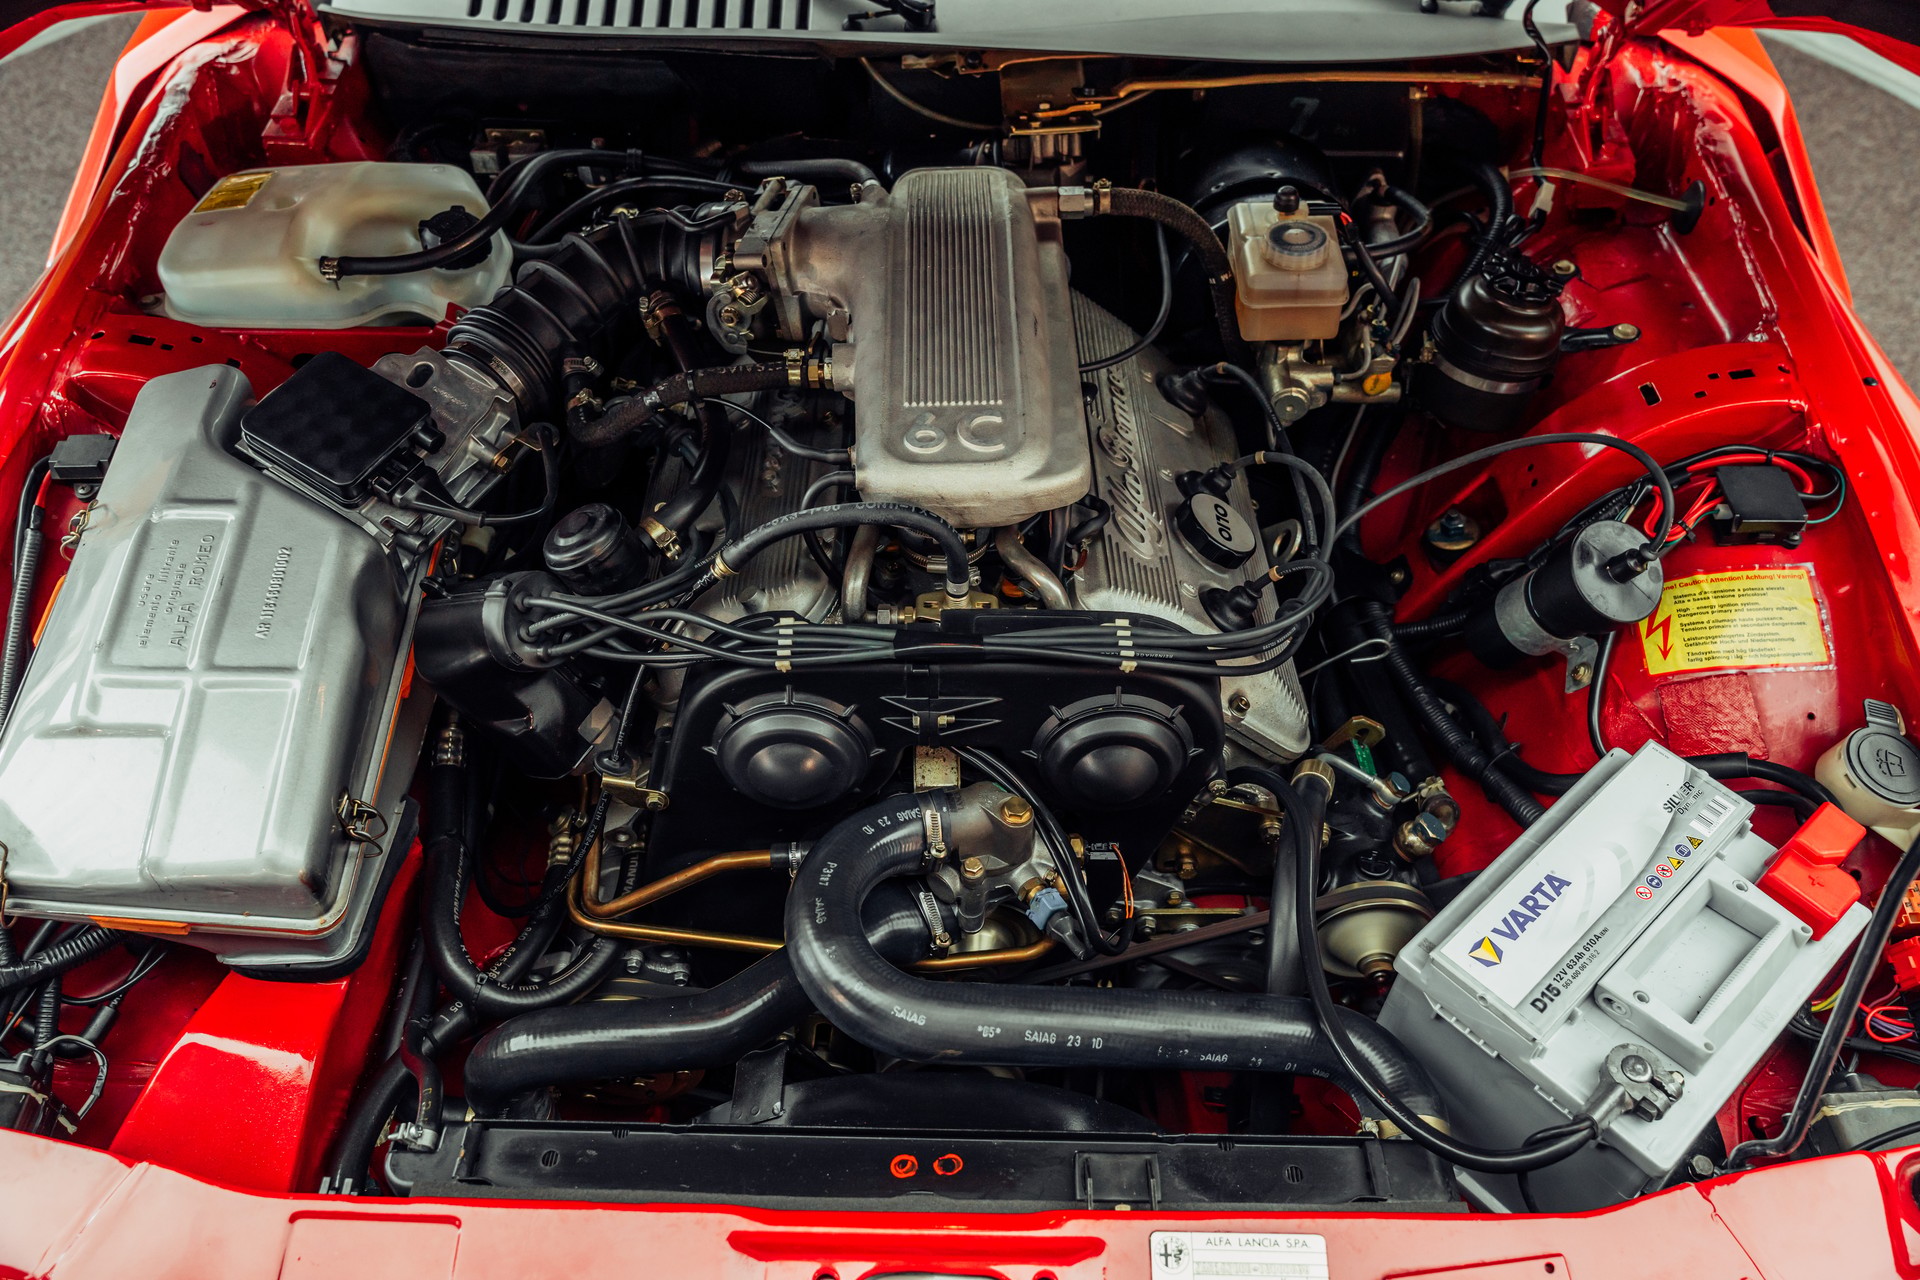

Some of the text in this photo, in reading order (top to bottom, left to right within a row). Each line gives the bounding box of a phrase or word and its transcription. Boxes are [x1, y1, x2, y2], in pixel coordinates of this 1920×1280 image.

[903, 411, 1005, 454] 6C
[1106, 472, 1163, 559] Alfa
[1214, 504, 1232, 542] OLIO
[138, 574, 155, 608] usare
[138, 539, 180, 648] elemento filtrante
[164, 562, 187, 615] originale
[168, 534, 215, 650] ALFA ROMEO
[1679, 579, 1708, 588] Caution!
[1710, 574, 1744, 583] Attention!
[254, 621, 272, 640] AR
[1663, 781, 1694, 814] SILVER
[1491, 874, 1572, 941] VARTA
[1530, 984, 1562, 1014] D15
[1552, 965, 1568, 984] 12V
[1566, 950, 1586, 970] 63Ah
[1562, 976, 1573, 990] 563
[1570, 968, 1582, 980] 400
[1205, 1238, 1310, 1248] ALFA LANCIA S.P.A.
